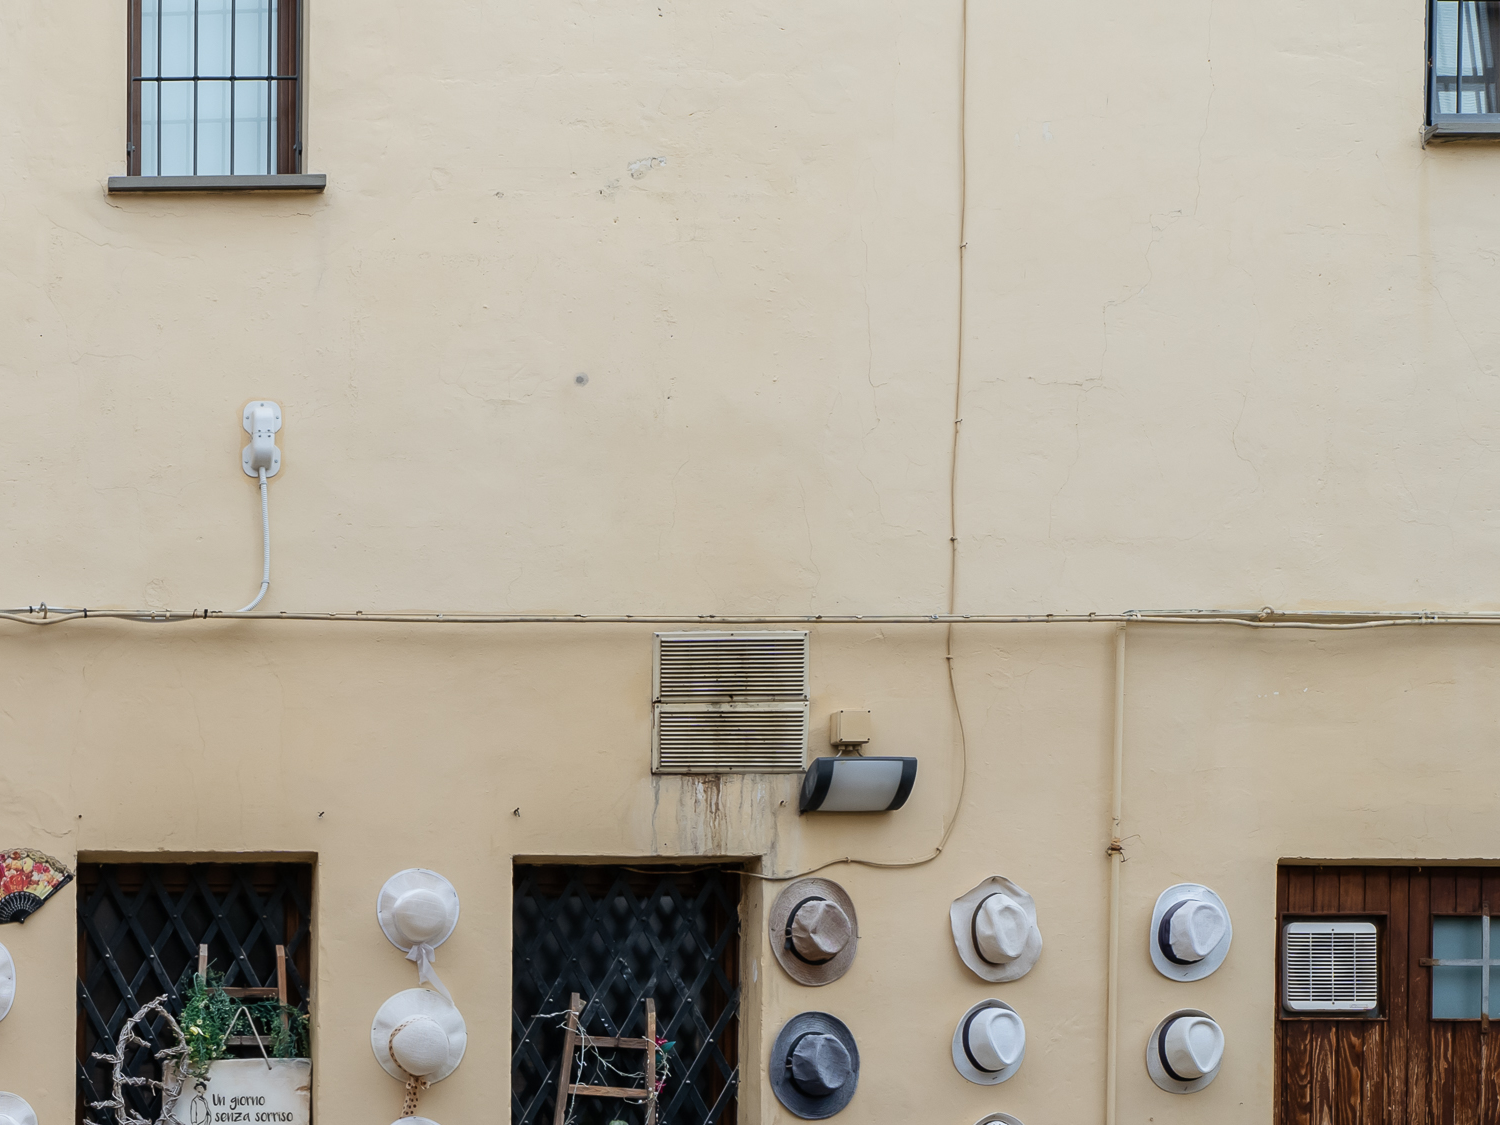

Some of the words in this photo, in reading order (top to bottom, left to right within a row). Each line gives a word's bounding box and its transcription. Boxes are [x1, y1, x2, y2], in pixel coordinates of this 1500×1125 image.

[212, 1093, 226, 1106] Un
[229, 1095, 266, 1110] giorno
[215, 1112, 250, 1122] senza
[254, 1112, 294, 1122] sorriso
